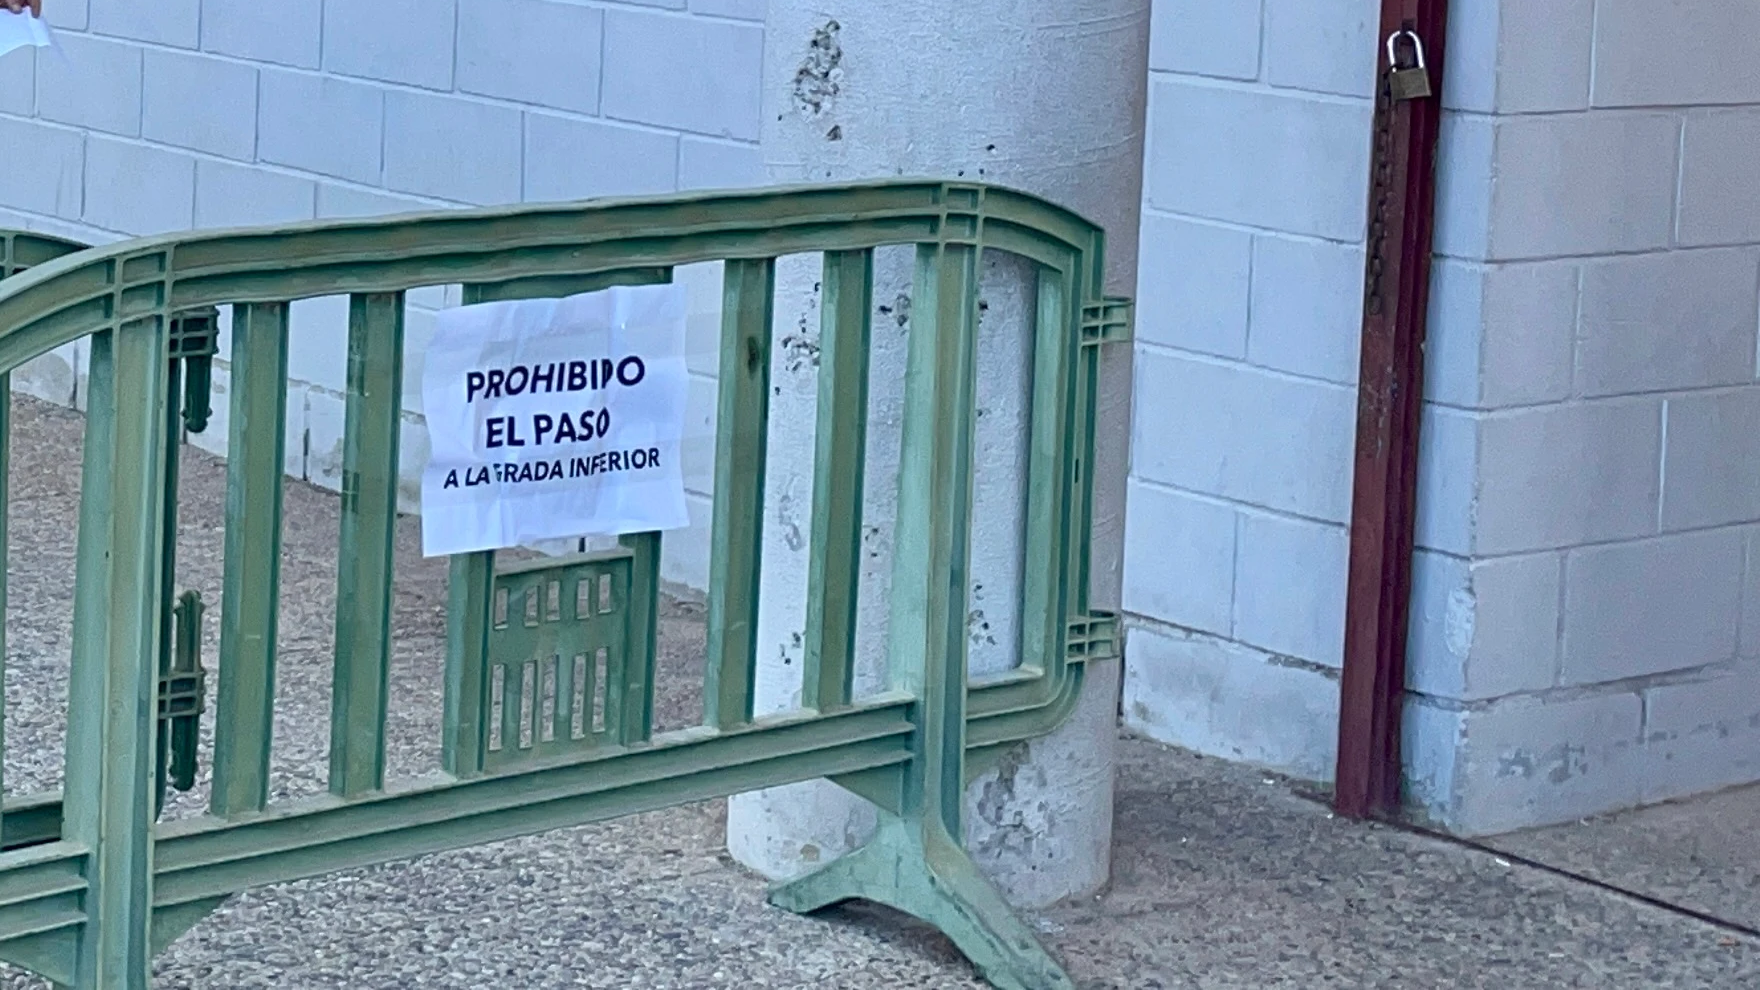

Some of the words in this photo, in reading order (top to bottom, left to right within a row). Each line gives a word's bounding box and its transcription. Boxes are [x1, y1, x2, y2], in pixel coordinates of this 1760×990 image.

[465, 355, 645, 403] PROHIBIDO
[485, 415, 525, 449] EL
[533, 406, 611, 445] PASO
[443, 468, 459, 490] A
[464, 466, 490, 486] LA
[569, 447, 661, 479] INFERIOR
